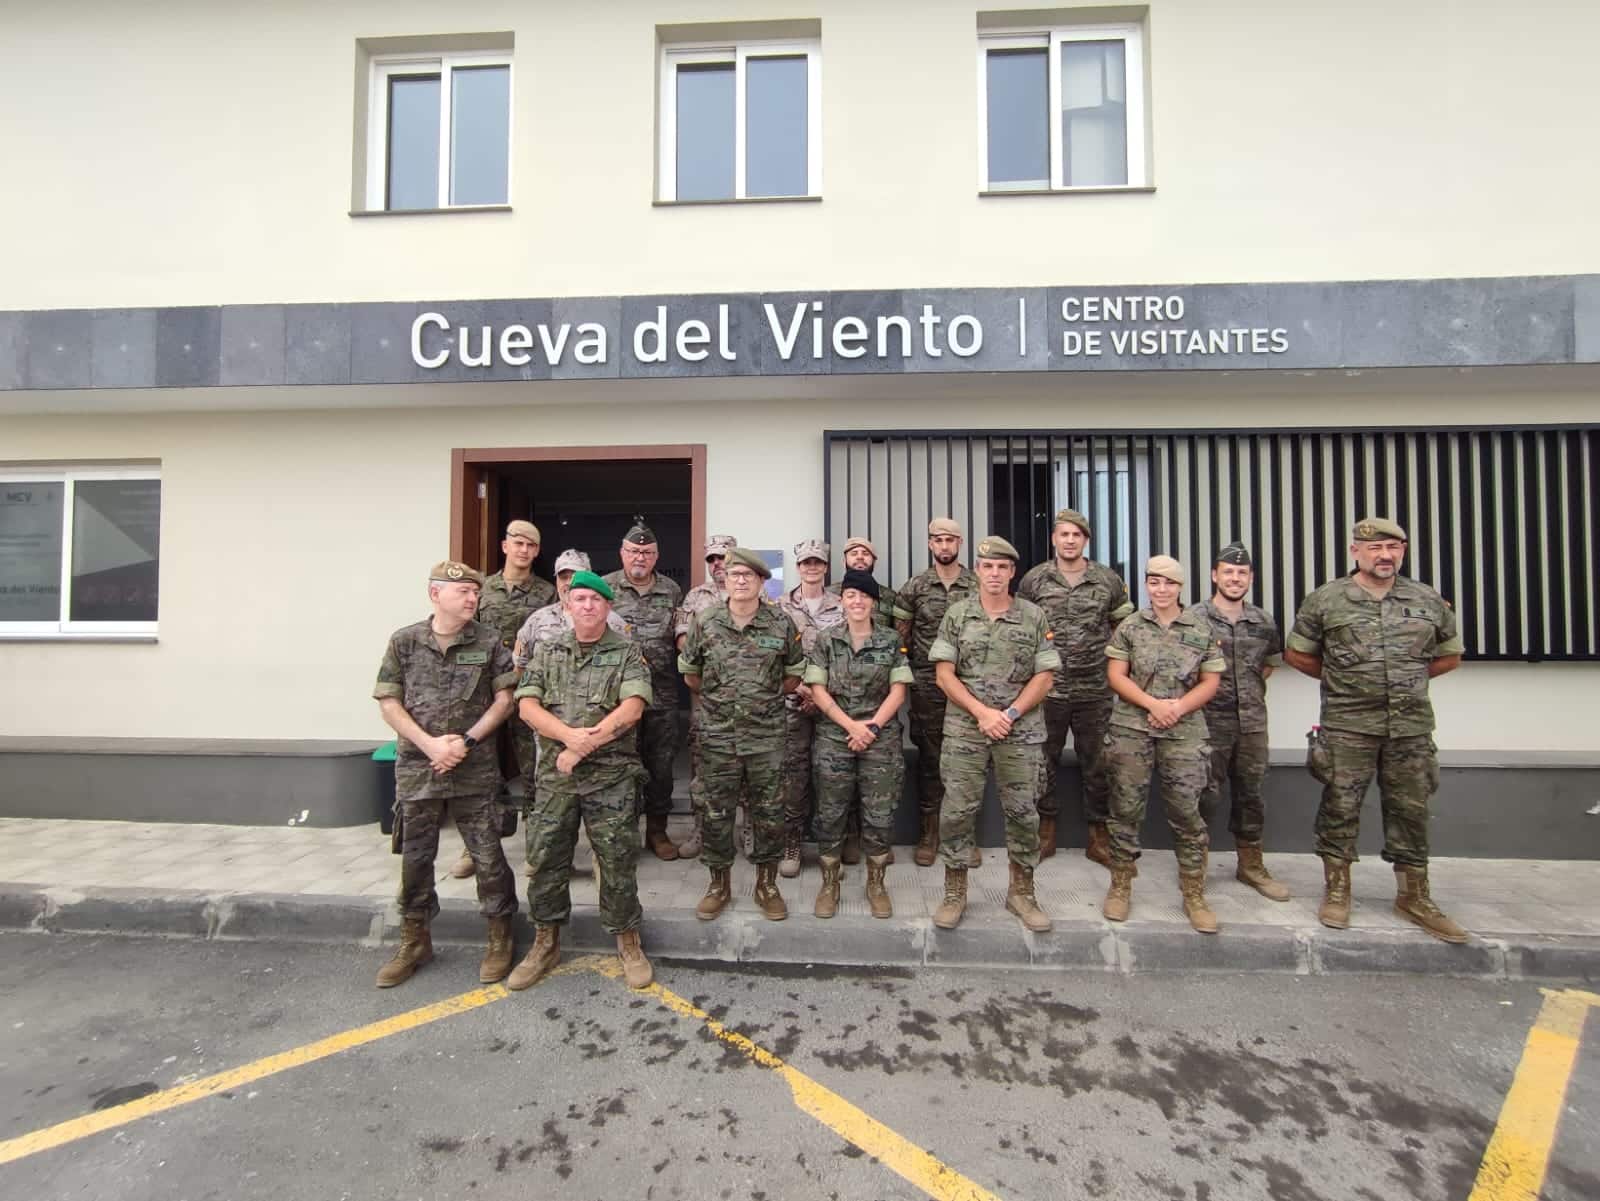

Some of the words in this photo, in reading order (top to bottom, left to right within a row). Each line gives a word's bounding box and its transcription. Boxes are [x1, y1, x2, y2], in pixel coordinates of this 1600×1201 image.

[1062, 296, 1185, 322] CENTRO
[410, 312, 608, 368] Cueva
[633, 304, 737, 362] del
[763, 302, 984, 360] Viento
[1063, 331, 1102, 355] DE
[1110, 328, 1289, 355] VISITANTES
